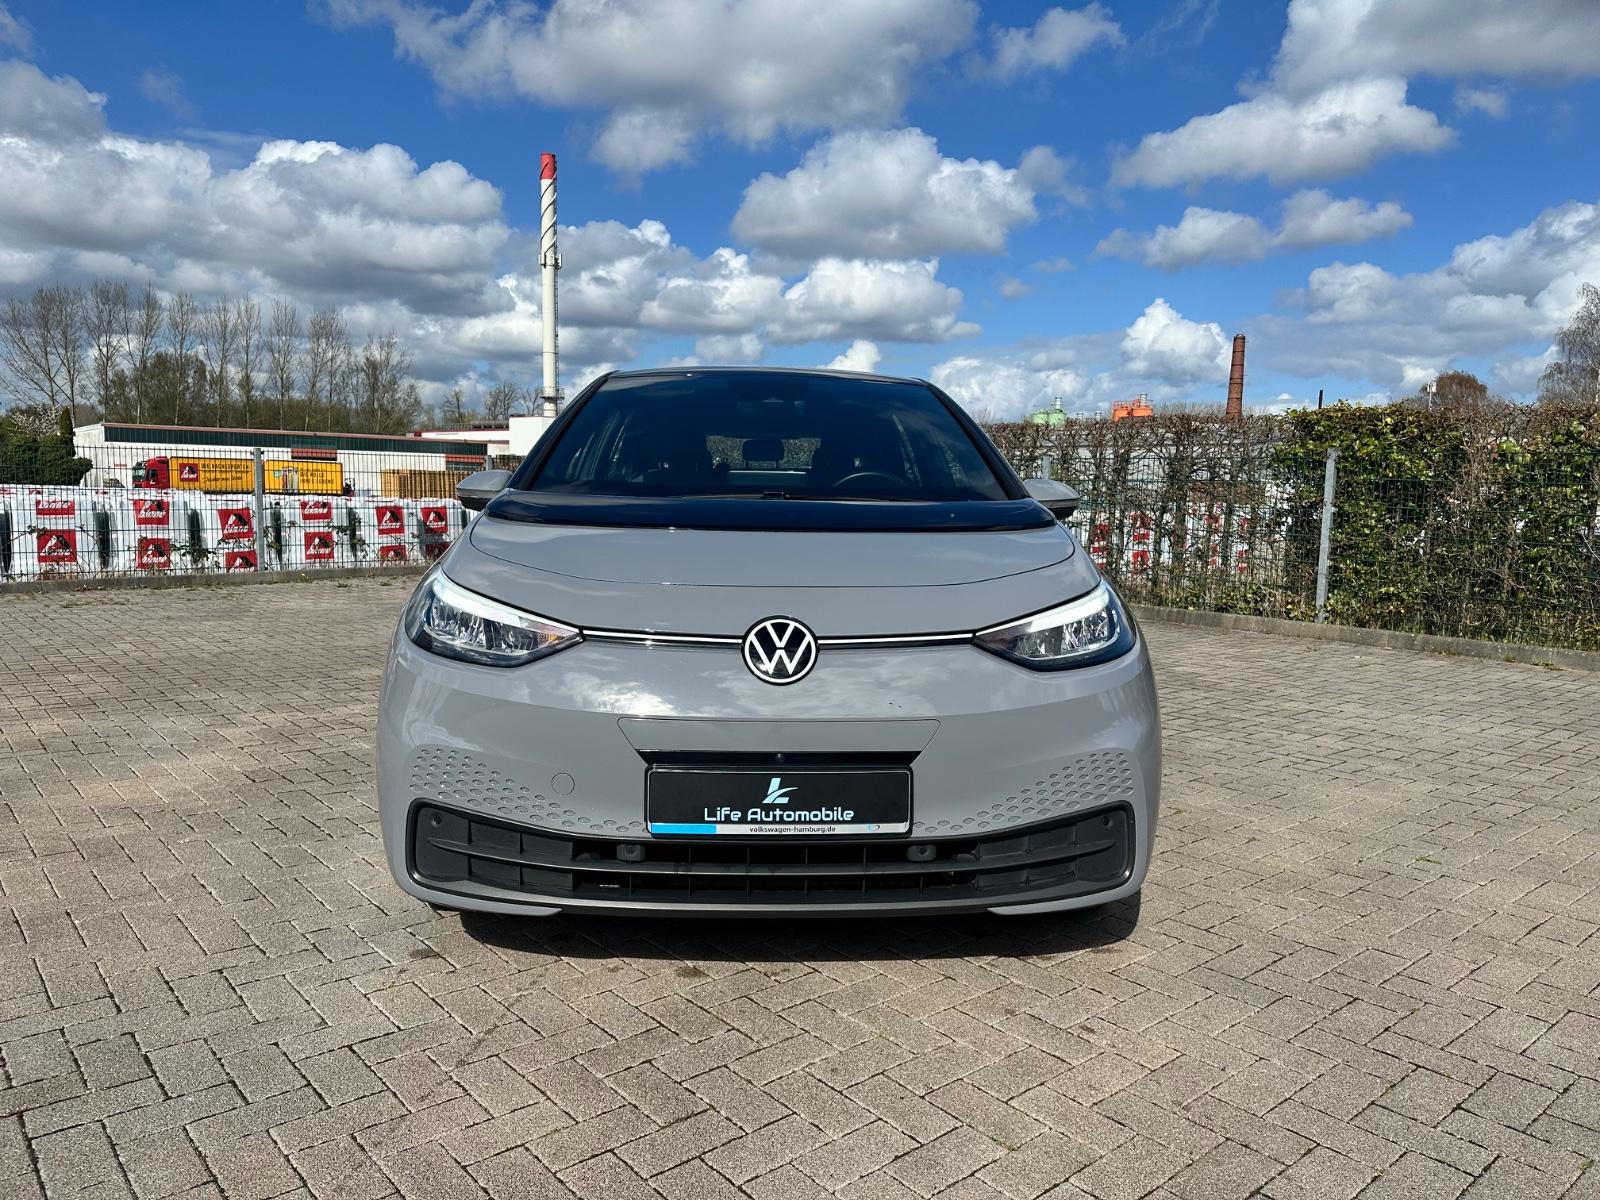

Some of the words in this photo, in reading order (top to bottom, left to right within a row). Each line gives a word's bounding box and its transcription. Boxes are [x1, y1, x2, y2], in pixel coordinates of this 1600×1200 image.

[704, 807, 742, 822] Life
[747, 806, 855, 822] Automobile
[750, 826, 837, 834] volkswagen-hamburg.de
